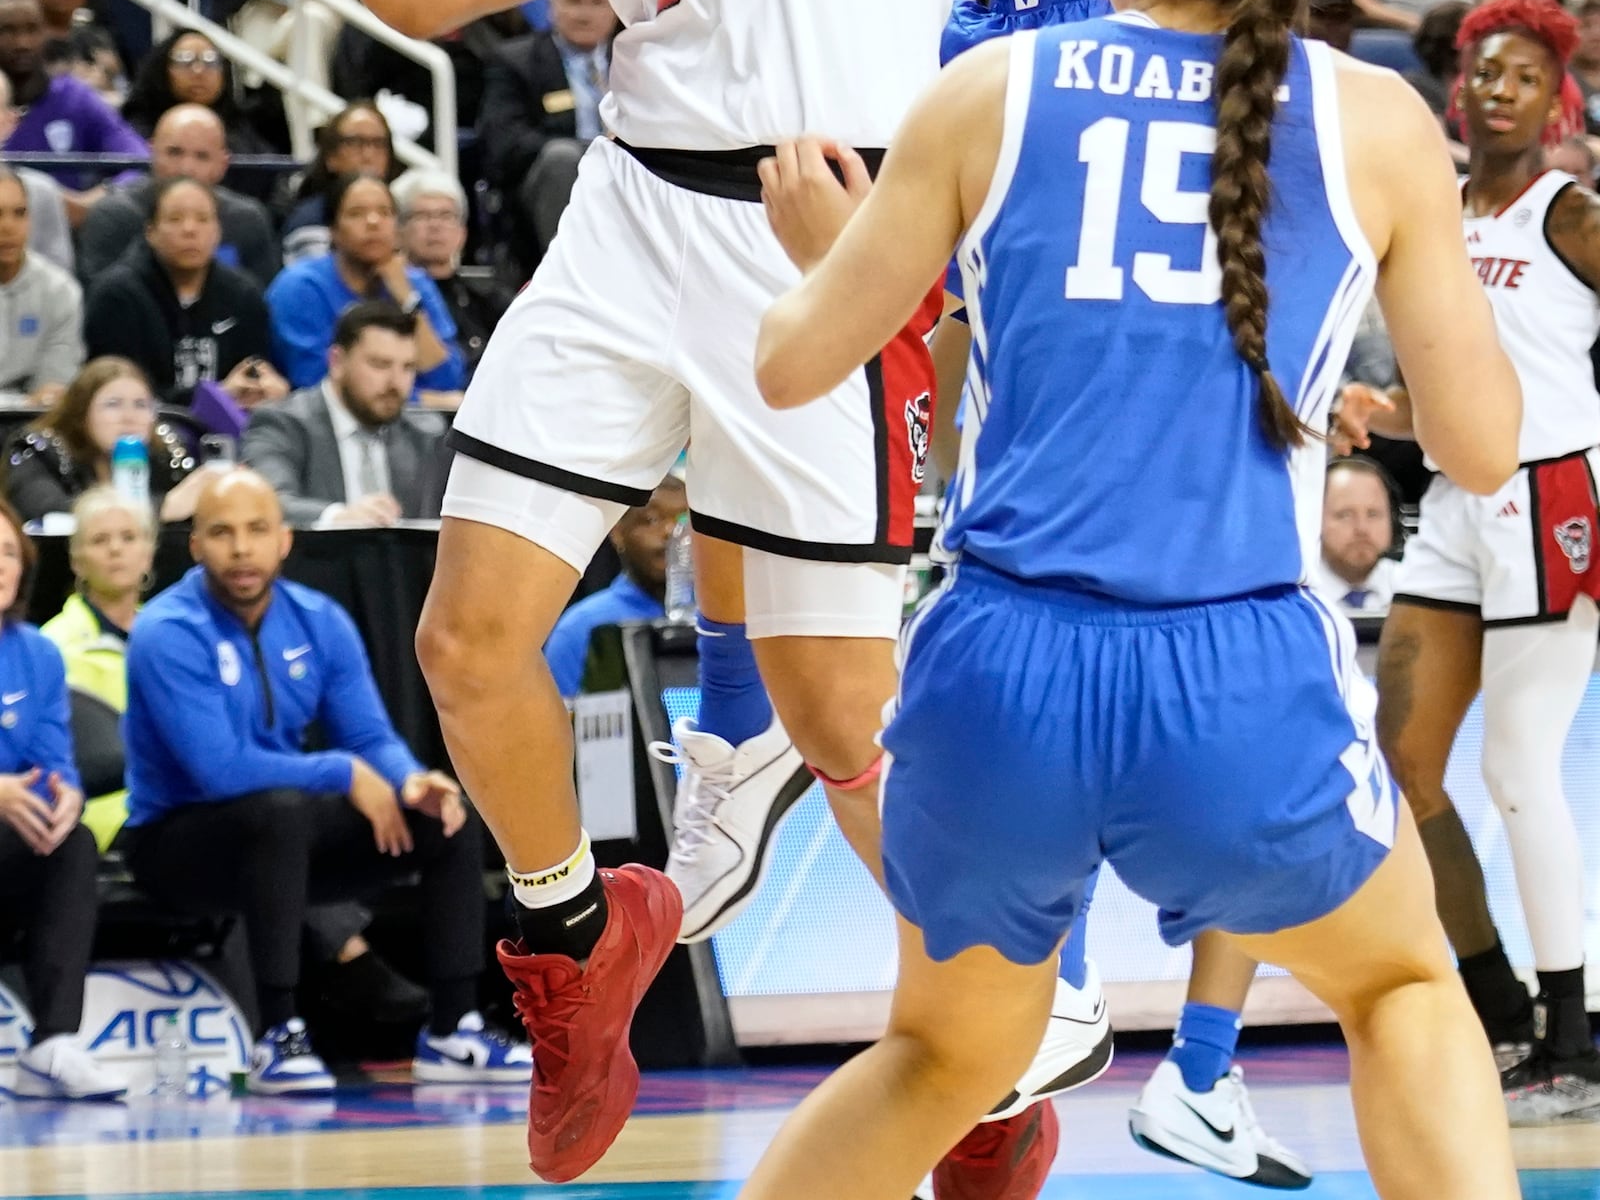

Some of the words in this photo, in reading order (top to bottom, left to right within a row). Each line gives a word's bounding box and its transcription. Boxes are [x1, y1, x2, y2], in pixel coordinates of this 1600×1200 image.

[1054, 39, 1290, 102] KOAB
[1065, 117, 1223, 304] 15
[1471, 257, 1531, 288] ATE
[511, 866, 569, 887] ALPHA
[88, 1008, 227, 1051] ACC
